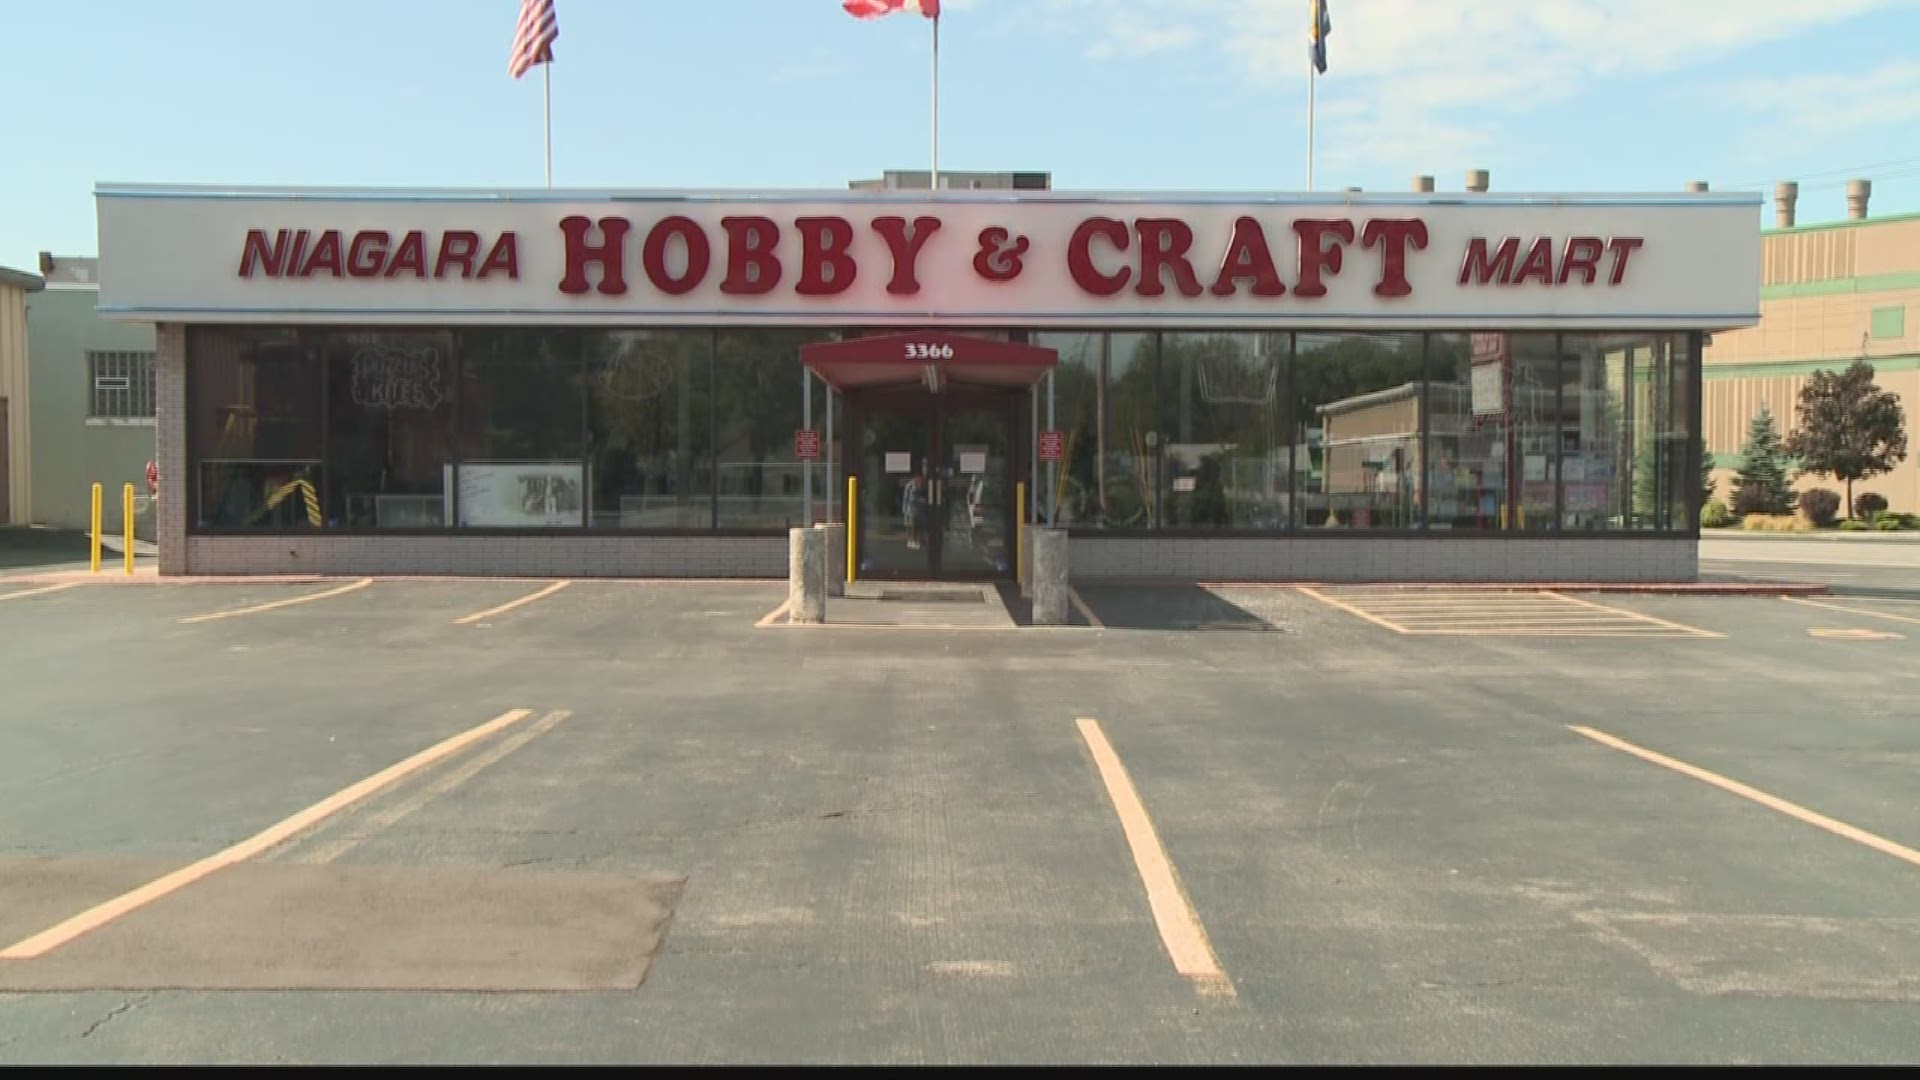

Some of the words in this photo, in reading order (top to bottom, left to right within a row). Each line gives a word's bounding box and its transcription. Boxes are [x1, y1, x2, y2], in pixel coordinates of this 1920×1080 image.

[238, 228, 520, 280] NIAGARA
[558, 215, 942, 297] HOBBY
[972, 226, 1030, 282] &
[1066, 216, 1429, 297] CRAFT
[1457, 236, 1644, 287] MART
[904, 342, 954, 361] 3366
